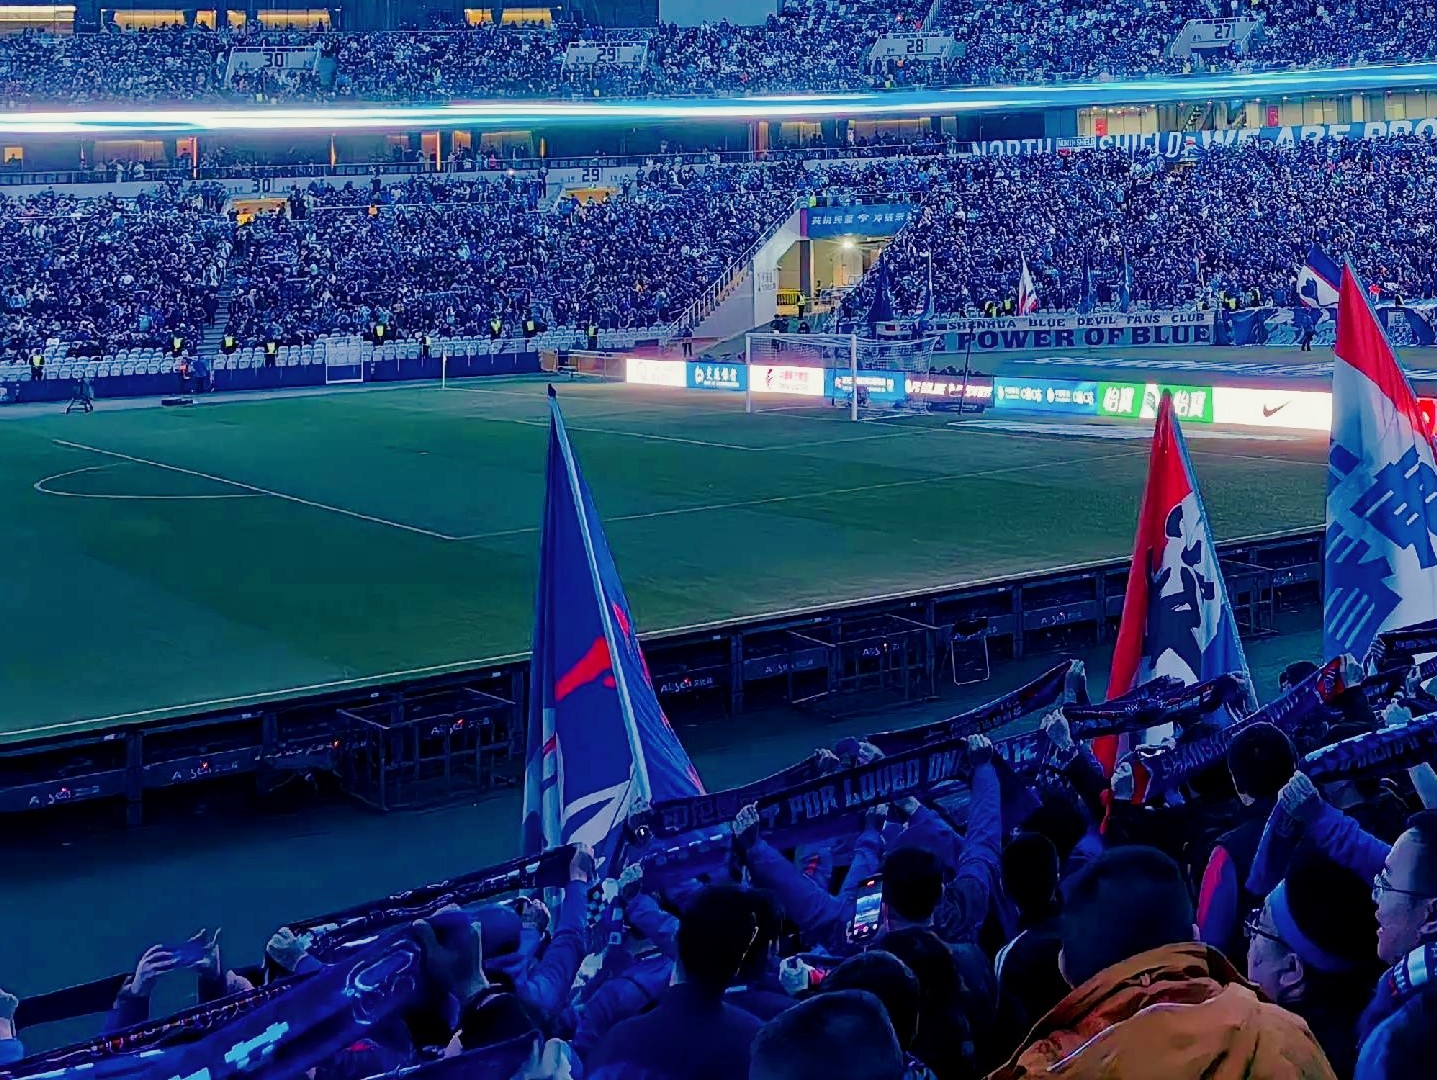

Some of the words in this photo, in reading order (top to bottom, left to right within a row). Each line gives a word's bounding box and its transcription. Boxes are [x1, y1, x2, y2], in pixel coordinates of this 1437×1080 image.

[1214, 24, 1231, 39] 27
[906, 38, 924, 54] 28
[262, 52, 284, 68] 30
[597, 47, 616, 62] 29
[581, 167, 600, 182] 29
[251, 178, 271, 193] 30
[949, 320, 1017, 330] SHENHUA
[1029, 318, 1066, 327] BLUE
[1077, 315, 1117, 326] DEVIL
[1127, 314, 1161, 325] FANS
[1171, 312, 1205, 322] CLUB
[957, 328, 1075, 350] POWER
[1084, 327, 1125, 346] OF
[1131, 324, 1211, 345] BLUE
